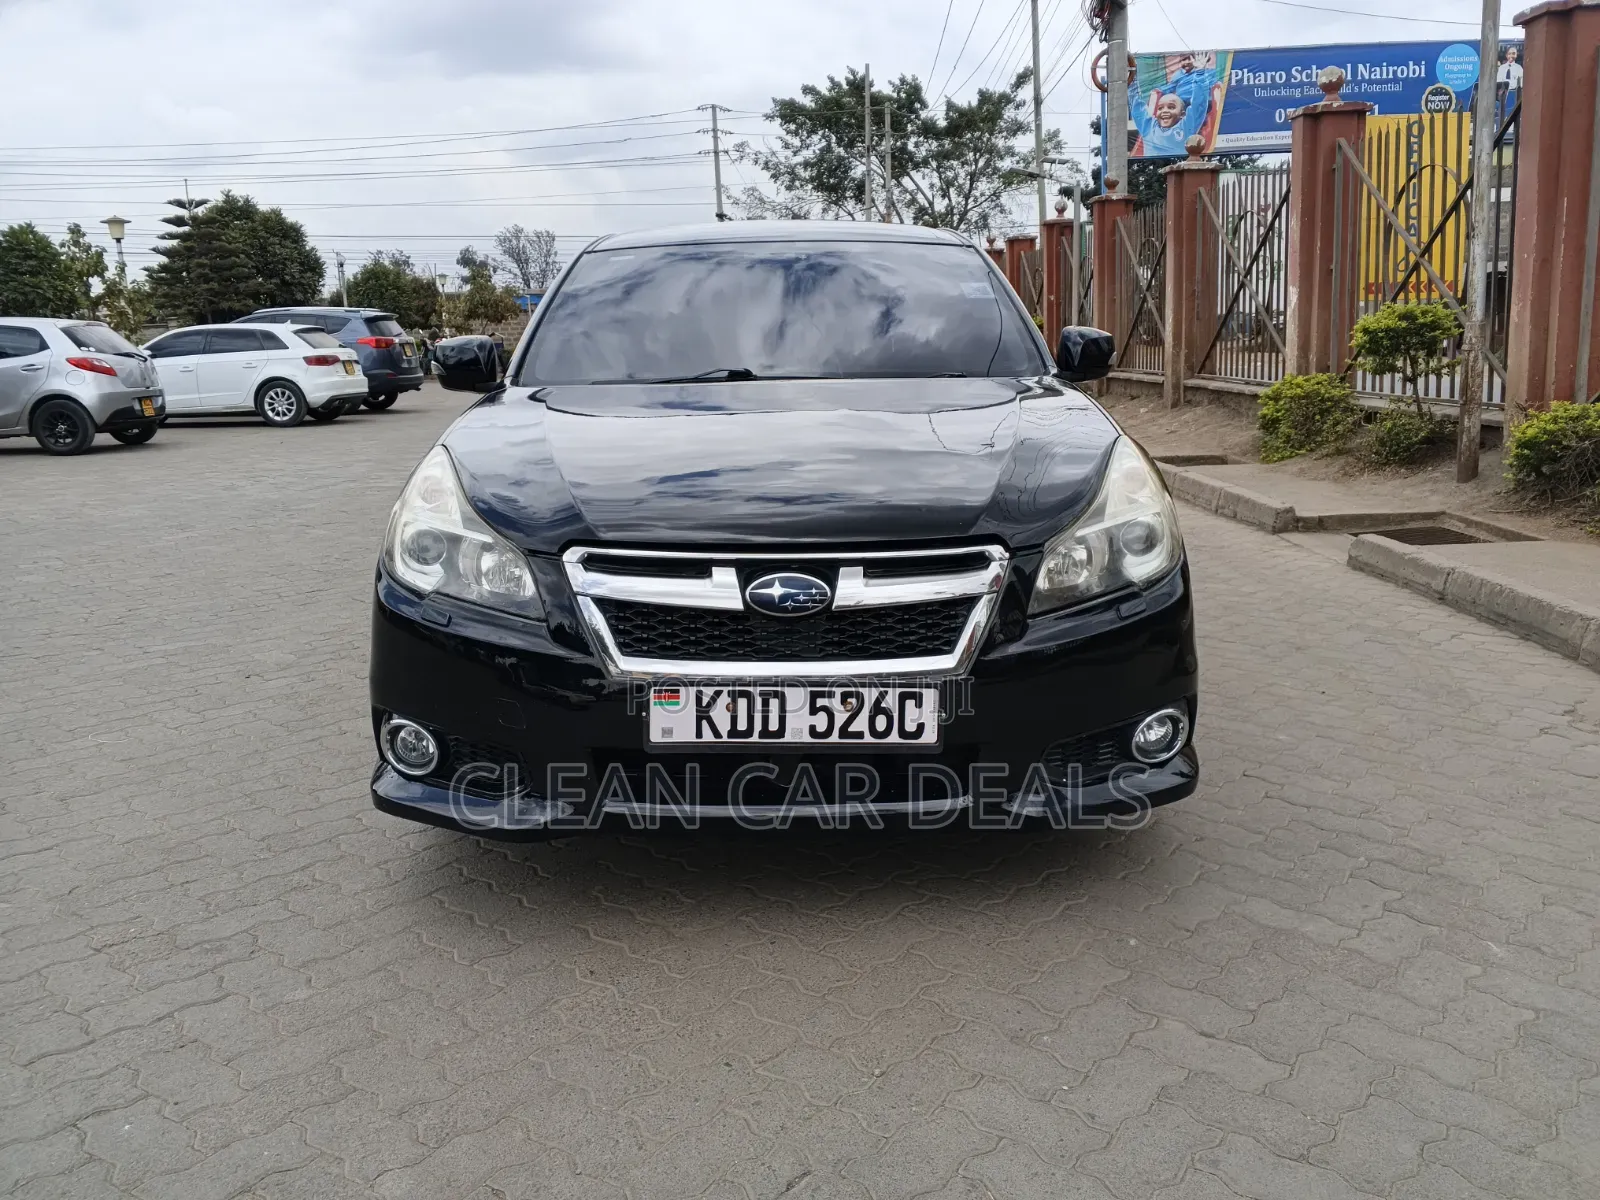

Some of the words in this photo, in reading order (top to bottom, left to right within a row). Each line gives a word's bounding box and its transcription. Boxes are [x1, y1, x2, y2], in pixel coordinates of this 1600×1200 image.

[1444, 63, 1473, 71] Ongoing
[1230, 69, 1286, 86] Pharo
[1291, 64, 1352, 83] Schl
[1357, 61, 1426, 80] Nairobi
[1254, 87, 1301, 98] Unlocking
[1361, 82, 1402, 92] Potential
[1428, 101, 1450, 110] NOW
[1246, 134, 1273, 142] Education
[695, 689, 787, 740] KDD
[808, 689, 926, 740] 526C
